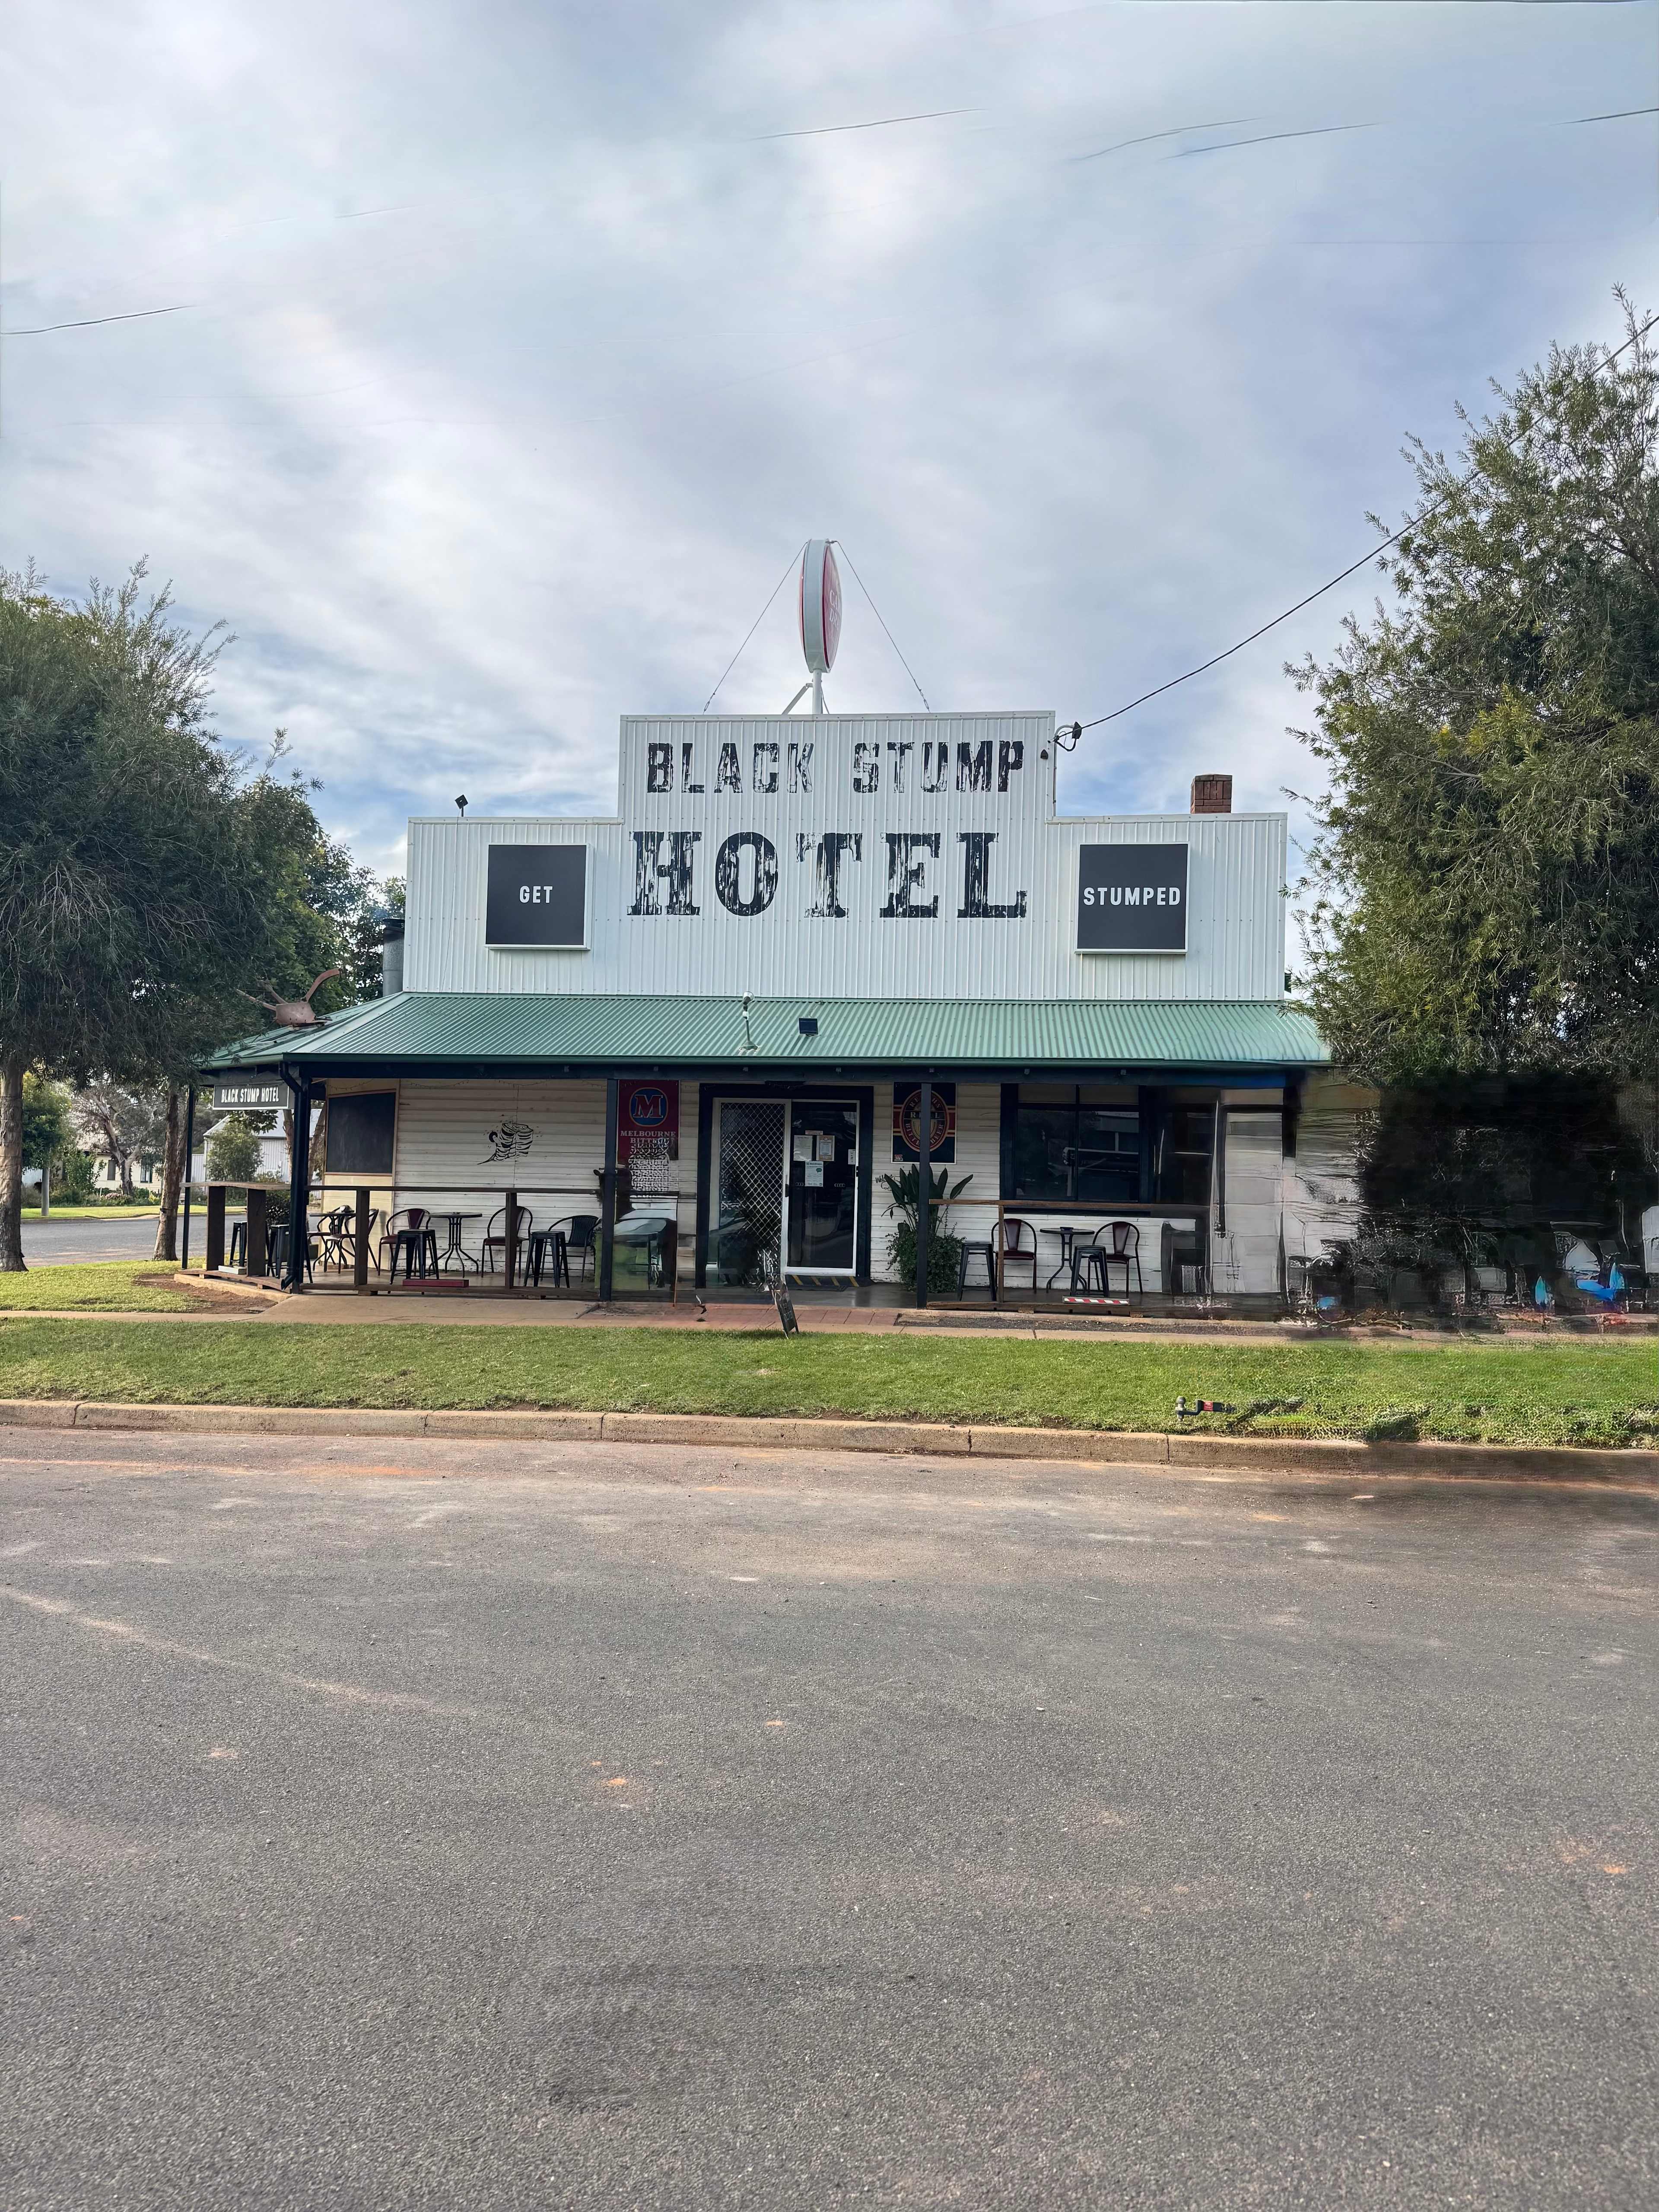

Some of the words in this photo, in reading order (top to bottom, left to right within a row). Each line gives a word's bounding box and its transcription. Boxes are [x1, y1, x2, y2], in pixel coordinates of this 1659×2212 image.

[647, 742, 814, 793] BLACK
[853, 740, 1023, 793] STUMP
[626, 830, 1027, 918] HOTEL
[519, 886, 553, 903] GET
[1084, 887, 1180, 906] STUMPED
[221, 1089, 238, 1103] BLACK
[240, 1088, 259, 1103] STUMP
[261, 1087, 279, 1102] HOTEL
[632, 1094, 664, 1118] M
[930, 1124, 944, 1144] BEER
